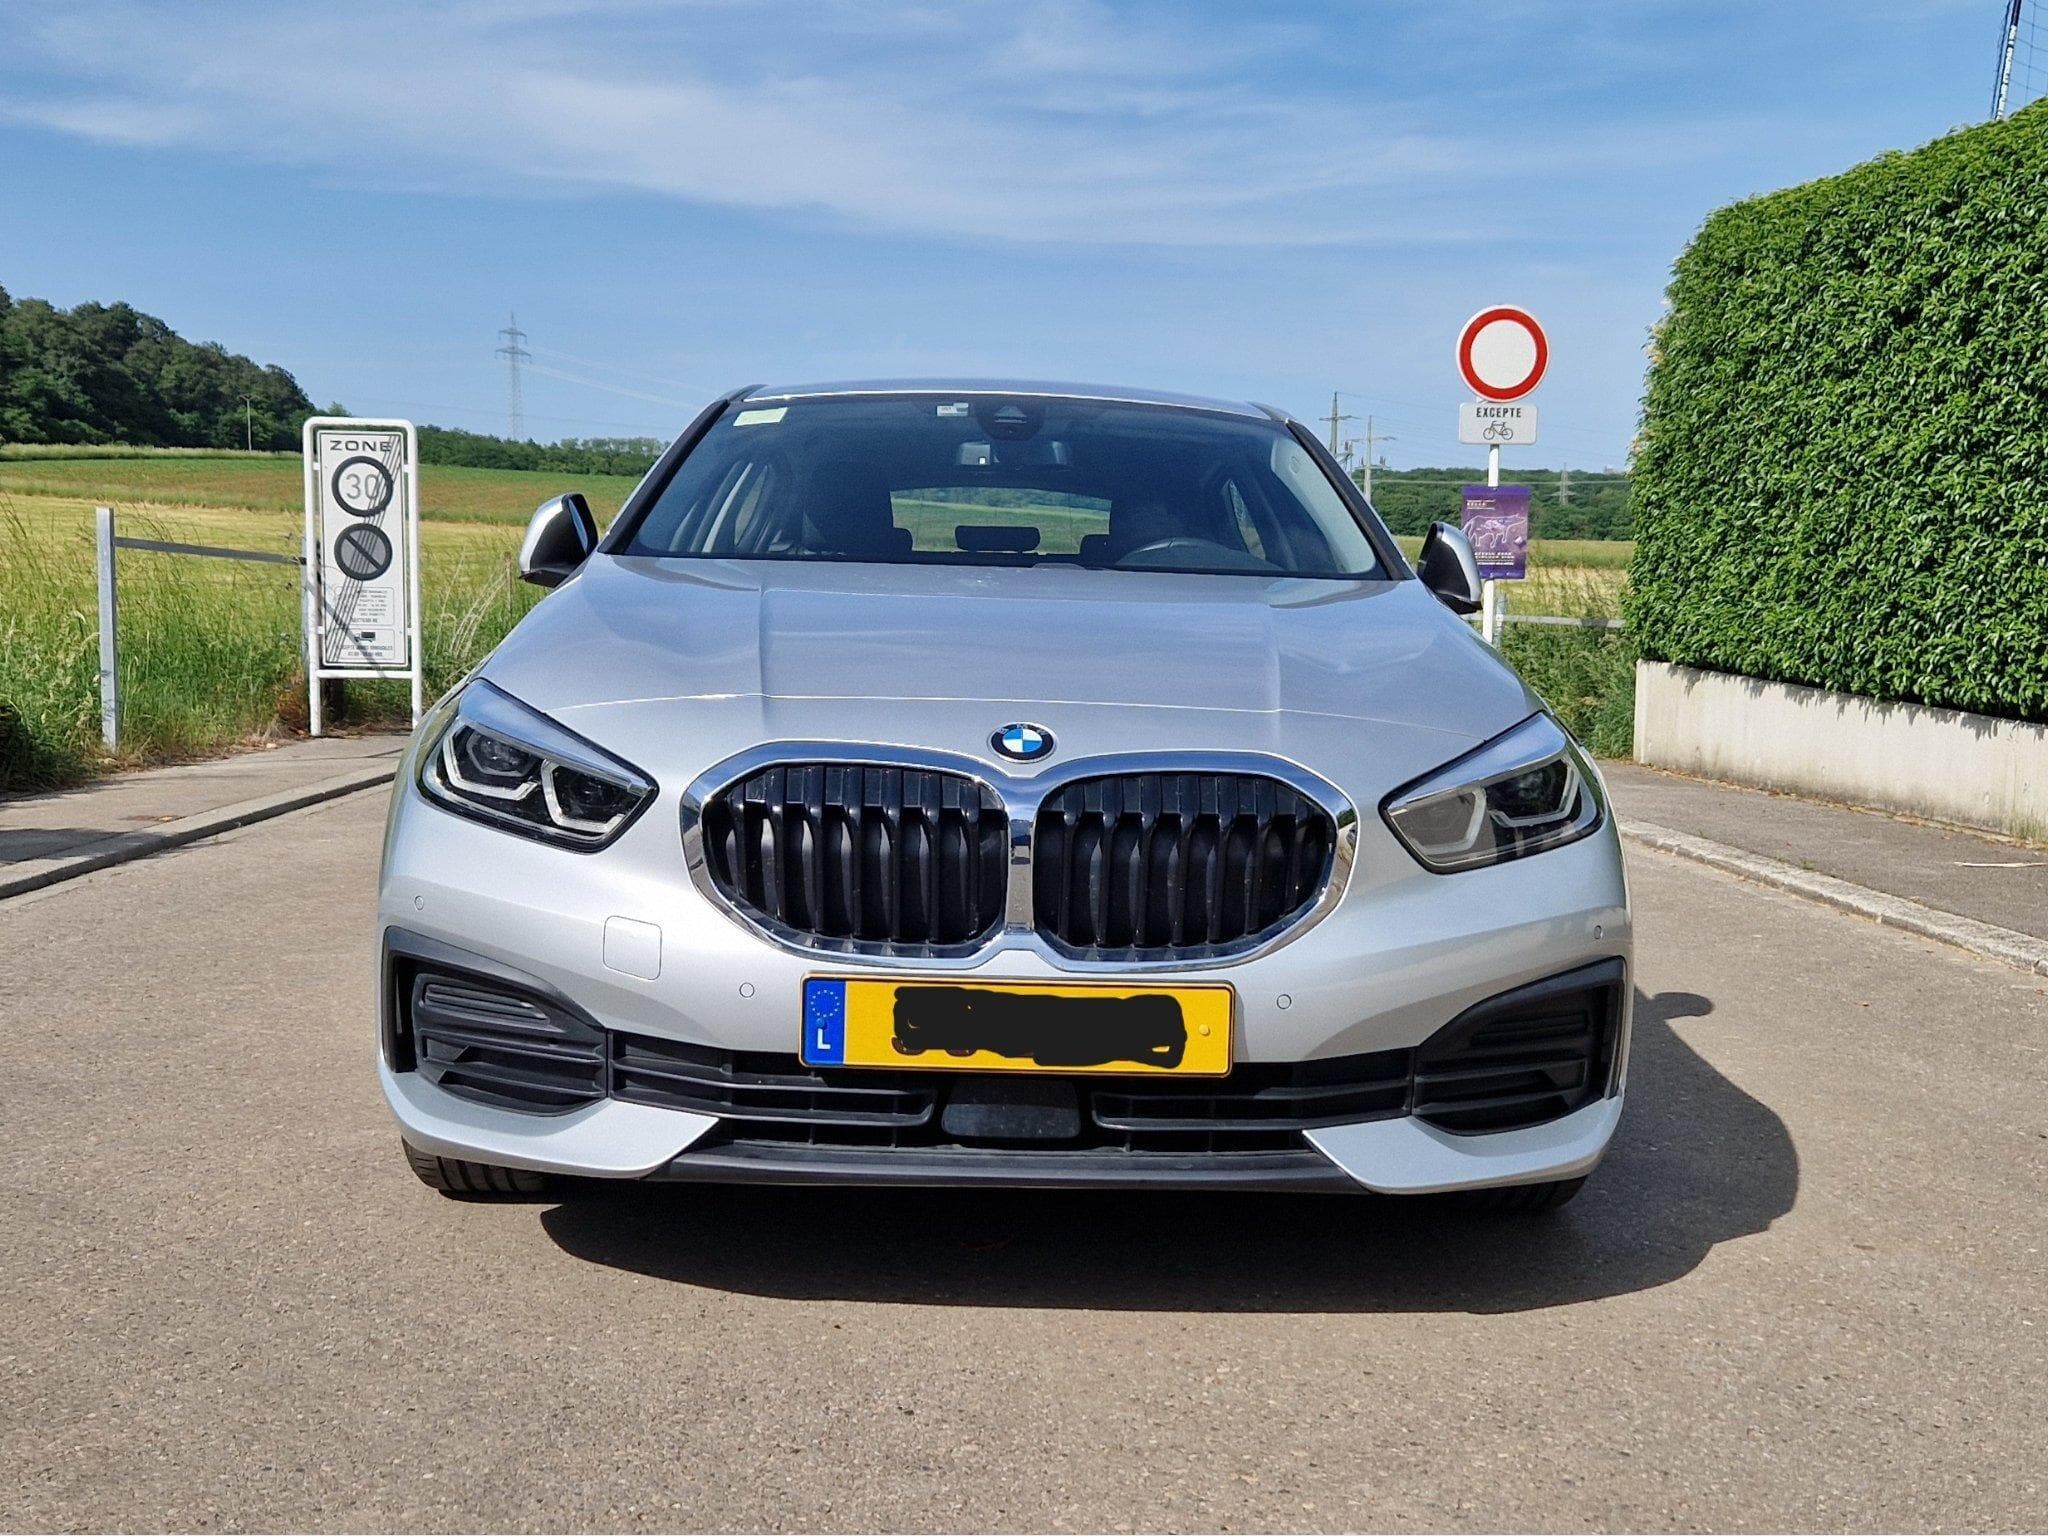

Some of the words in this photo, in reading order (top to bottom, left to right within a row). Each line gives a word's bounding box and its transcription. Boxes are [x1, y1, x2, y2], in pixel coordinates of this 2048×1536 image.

[1476, 407, 1522, 418] EXCEPTE
[329, 440, 392, 452] ZONE
[345, 473, 380, 500] 30
[817, 1028, 831, 1050] L
